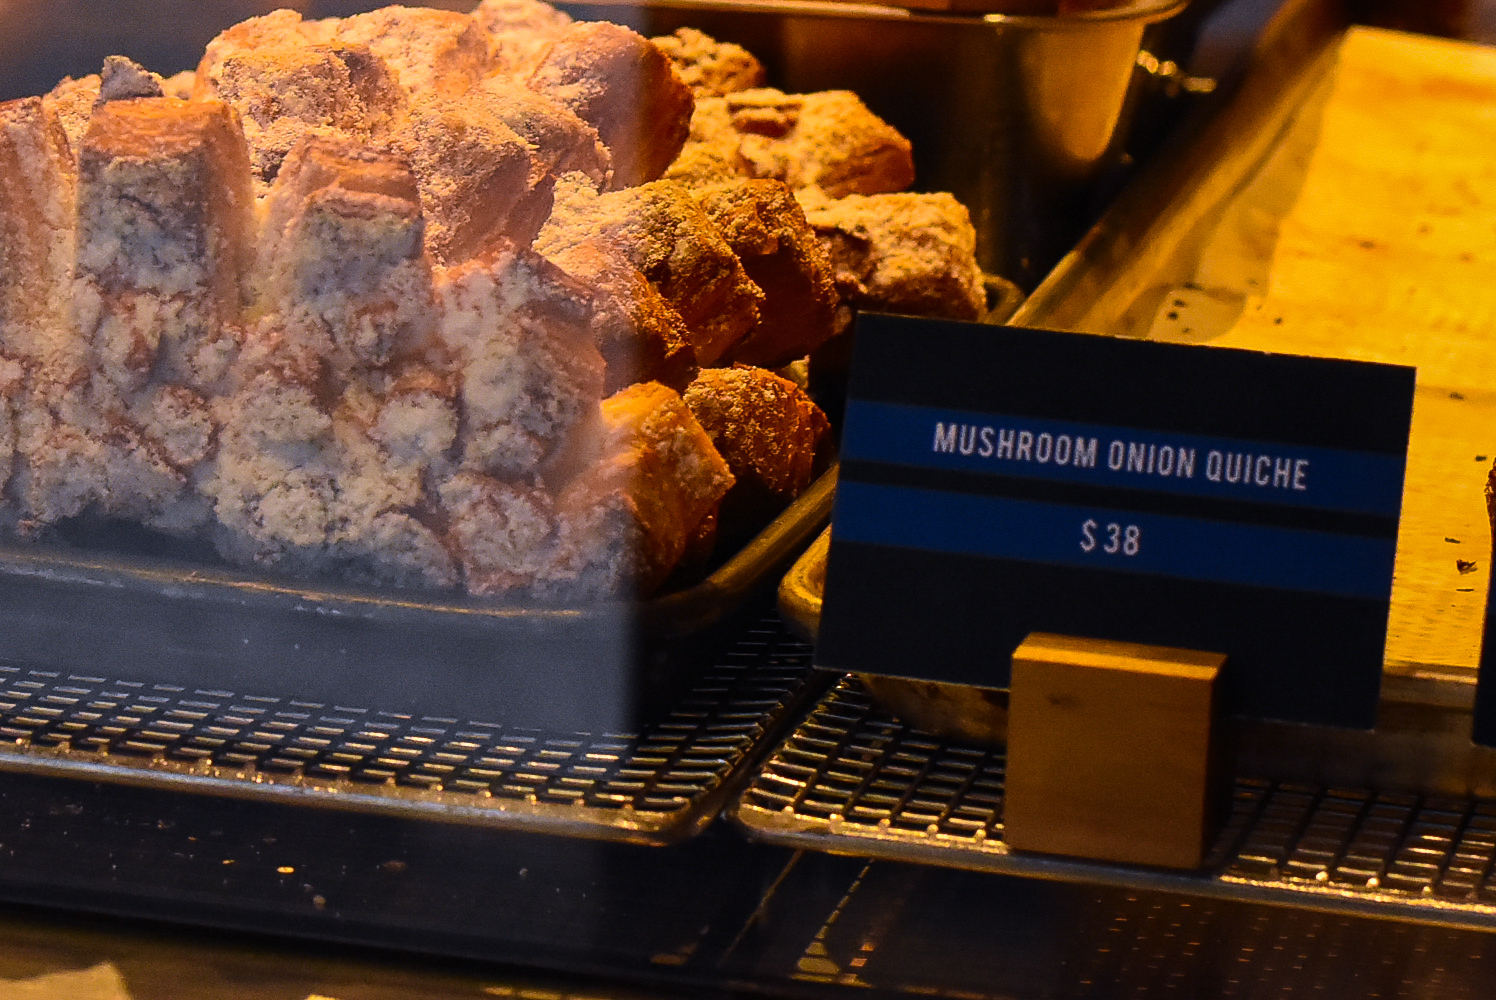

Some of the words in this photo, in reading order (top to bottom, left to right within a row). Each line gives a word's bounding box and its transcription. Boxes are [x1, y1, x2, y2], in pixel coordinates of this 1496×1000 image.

[933, 421, 1098, 468] MUSHROOM
[1108, 440, 1196, 479] ONION
[1205, 449, 1309, 491] QUICHE
